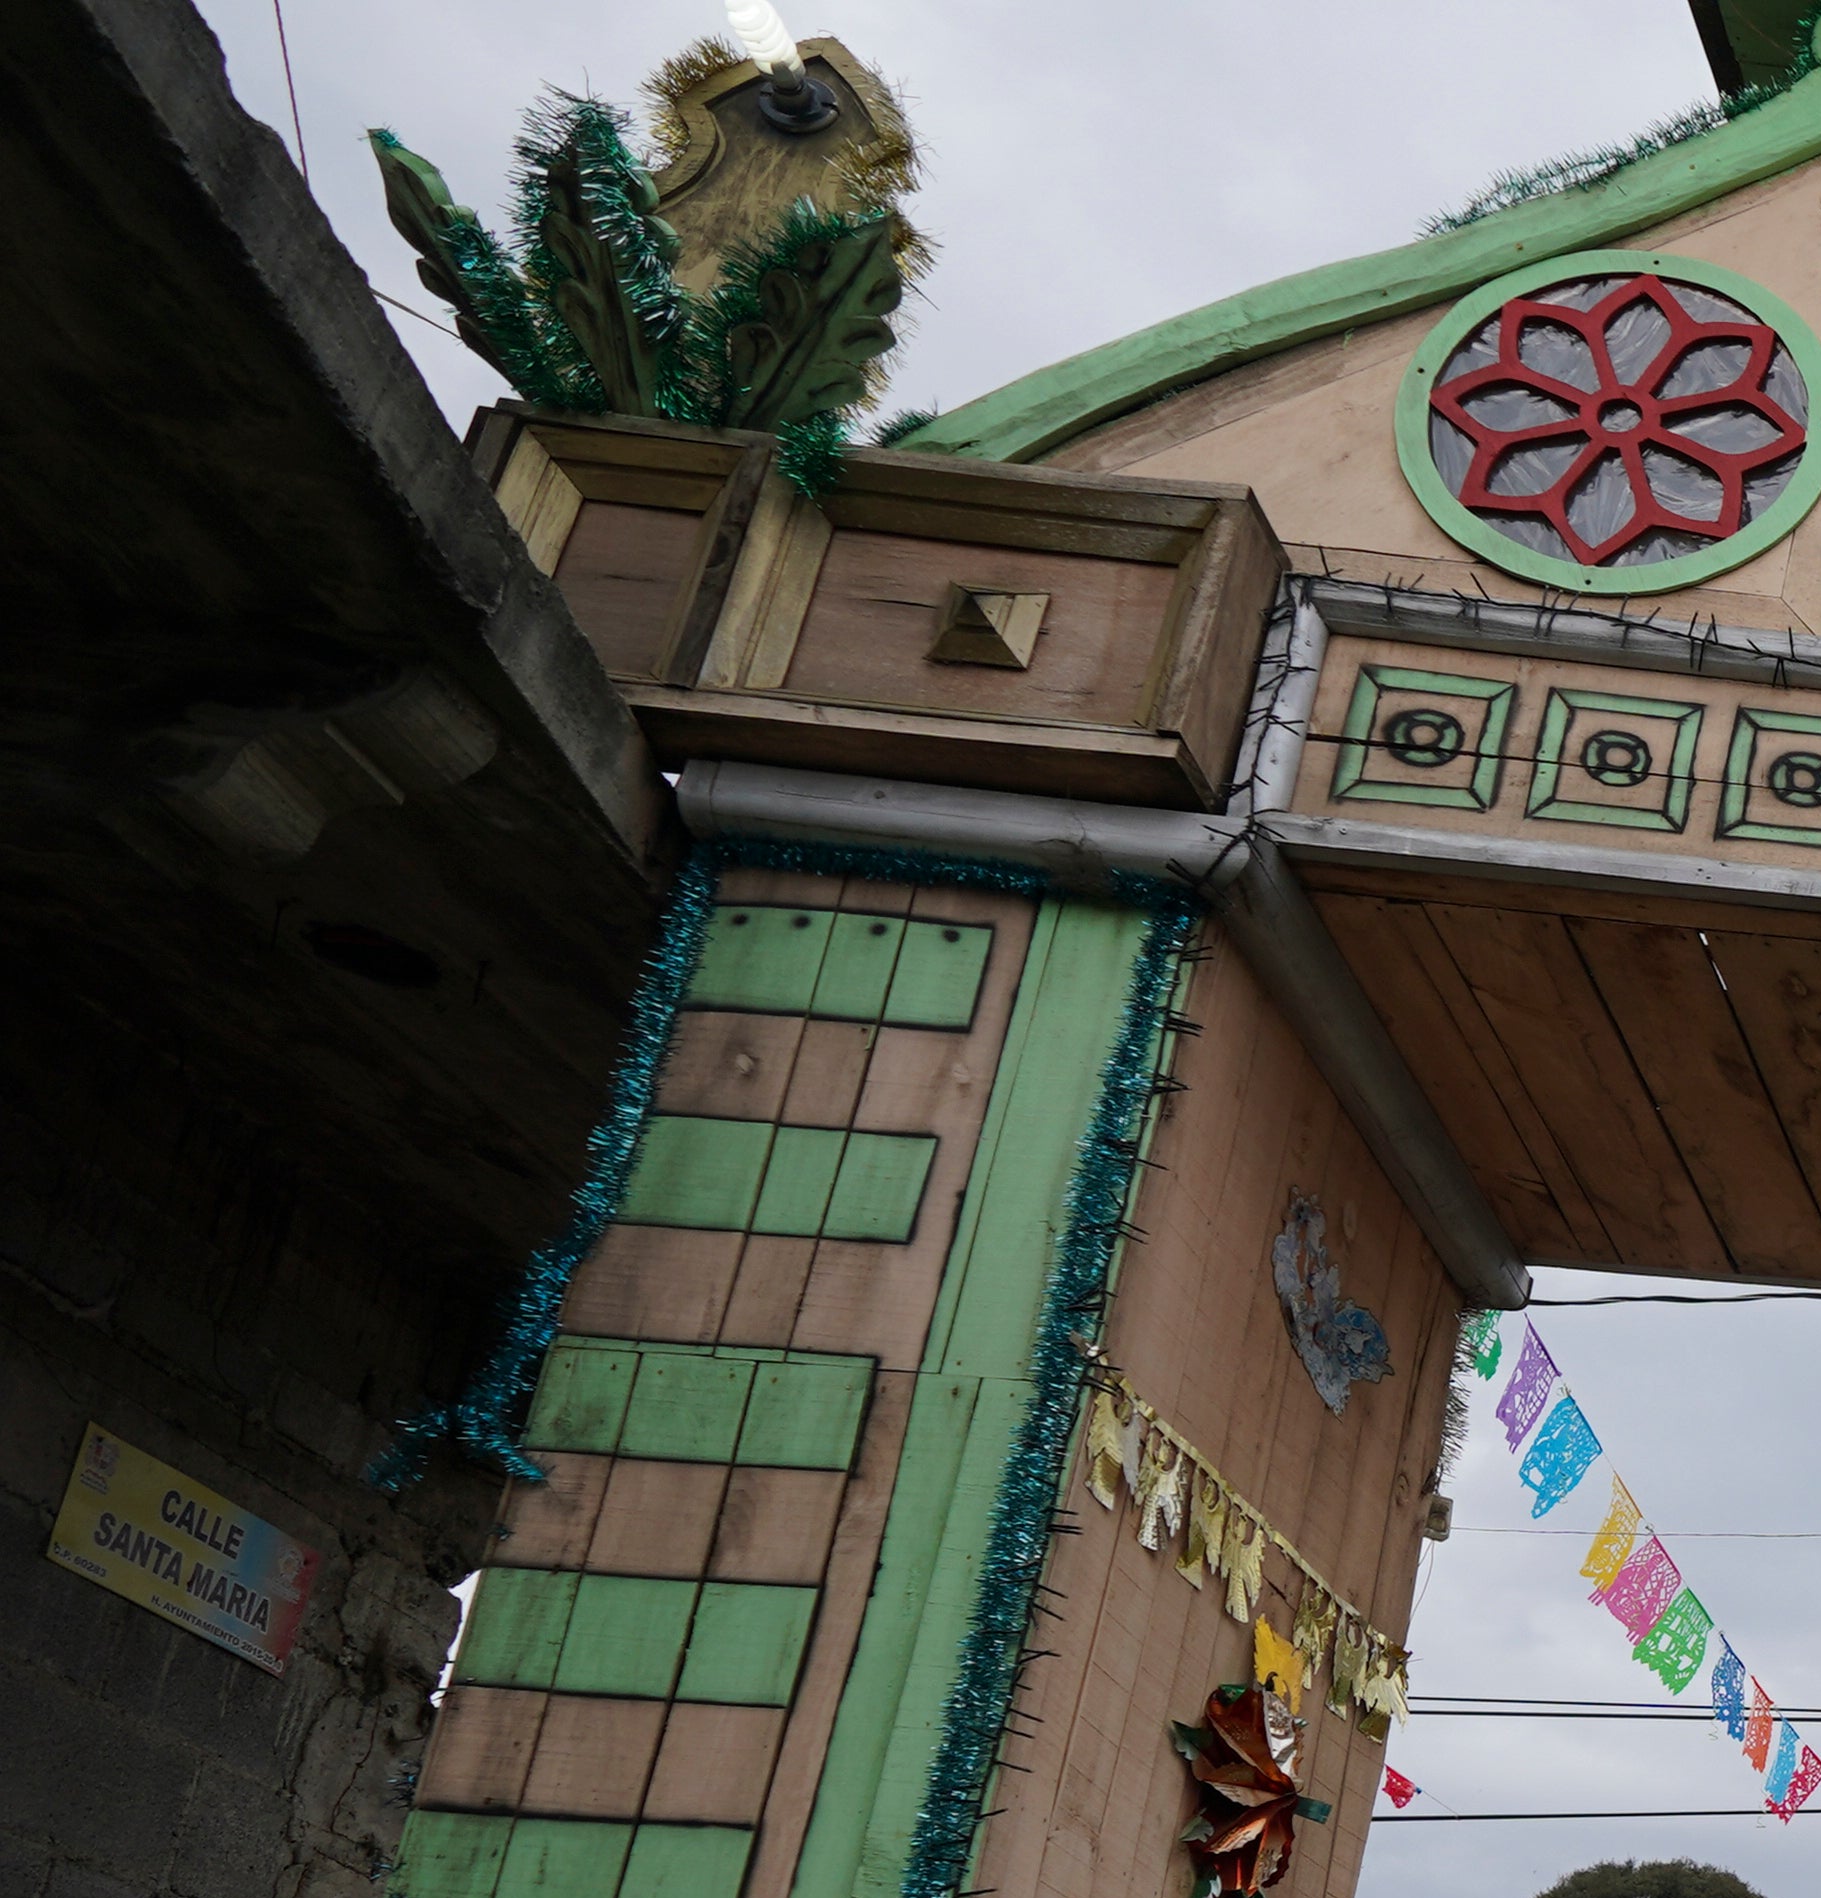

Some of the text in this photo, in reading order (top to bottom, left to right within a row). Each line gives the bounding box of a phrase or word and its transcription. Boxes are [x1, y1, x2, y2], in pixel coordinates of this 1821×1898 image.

[161, 1489, 244, 1559] CALLE
[94, 1512, 183, 1587] SANTA
[187, 1562, 271, 1632] MARIA
[151, 1595, 161, 1606] H.
[163, 1602, 240, 1646] AYUNTAMIENTO
